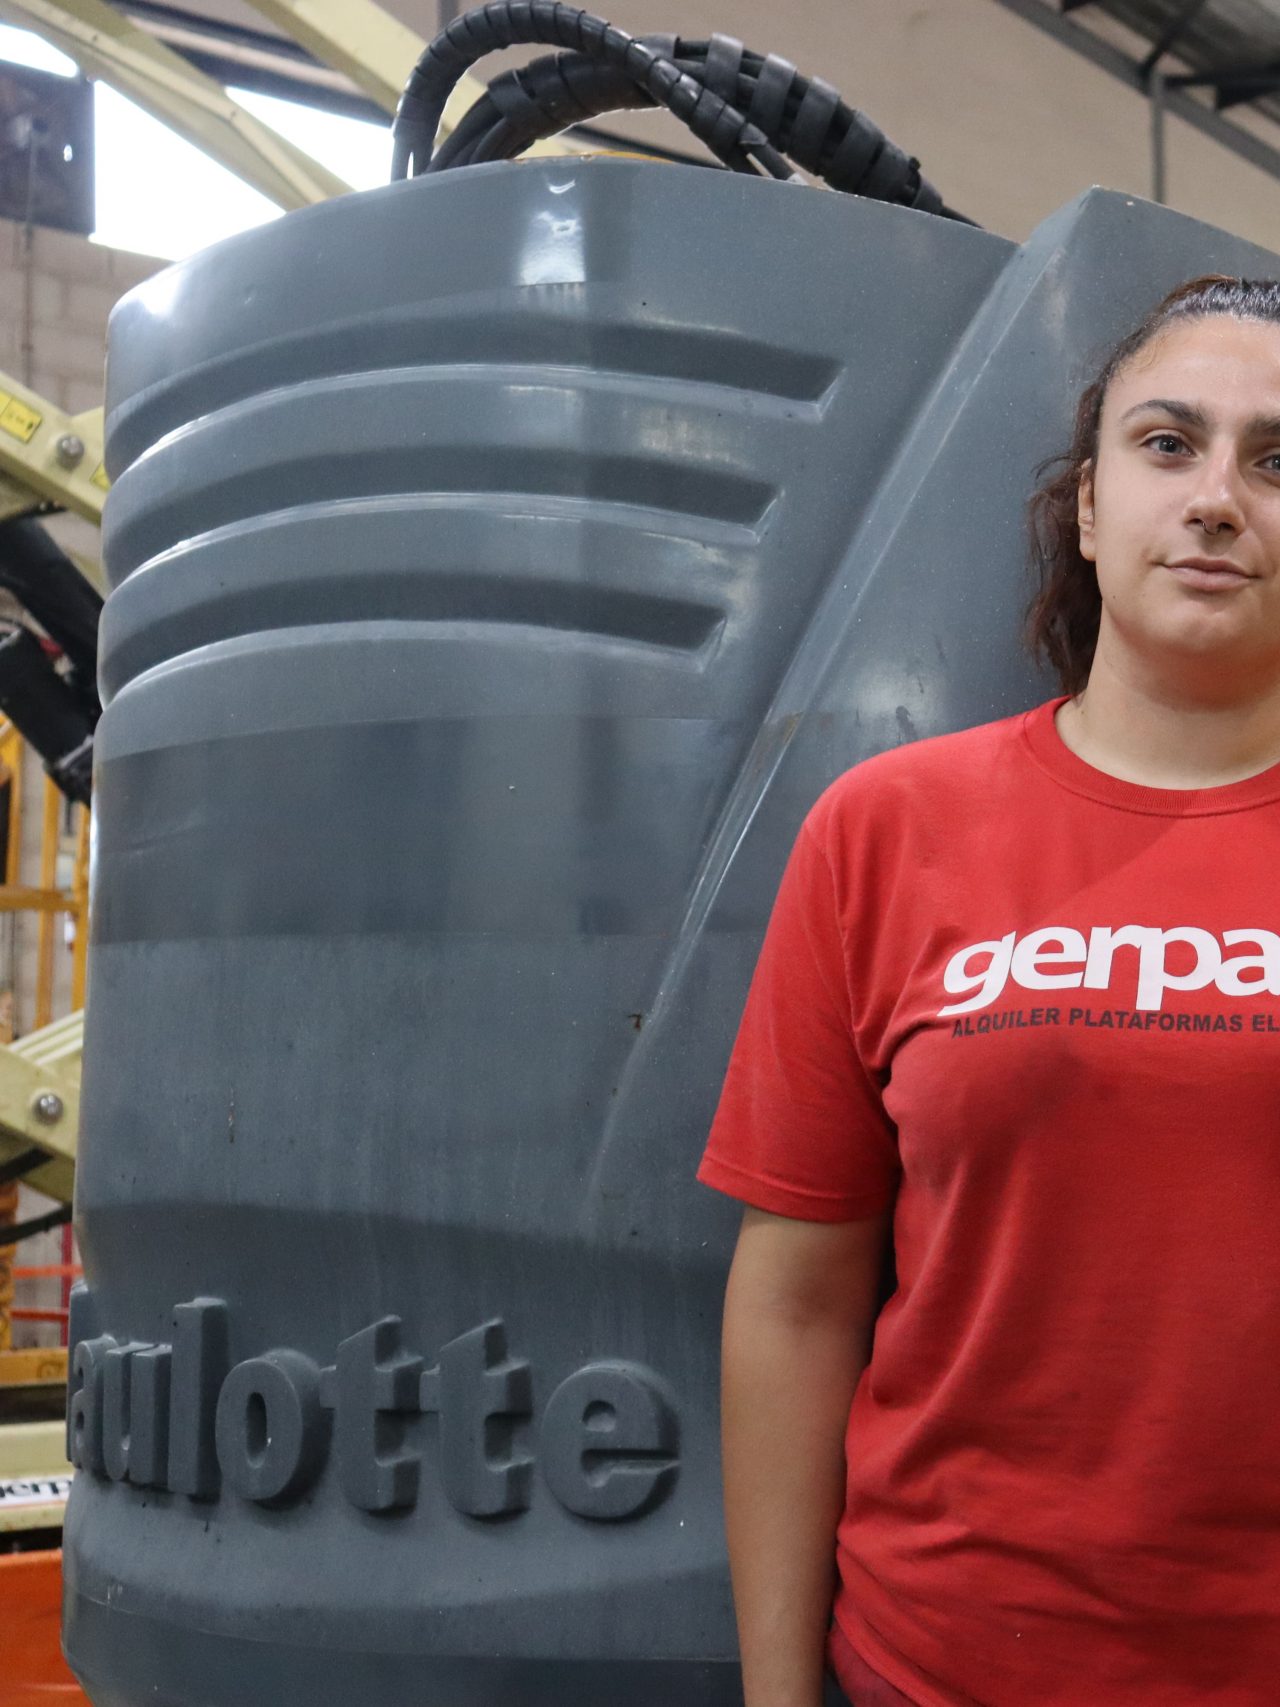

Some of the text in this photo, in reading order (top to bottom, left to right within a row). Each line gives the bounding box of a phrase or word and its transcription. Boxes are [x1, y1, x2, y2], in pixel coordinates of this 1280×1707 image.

[952, 1007, 1061, 1038] ALQUILER
[1069, 1007, 1243, 1033] PLATAFORMAS
[68, 1282, 680, 1524] aulotte
